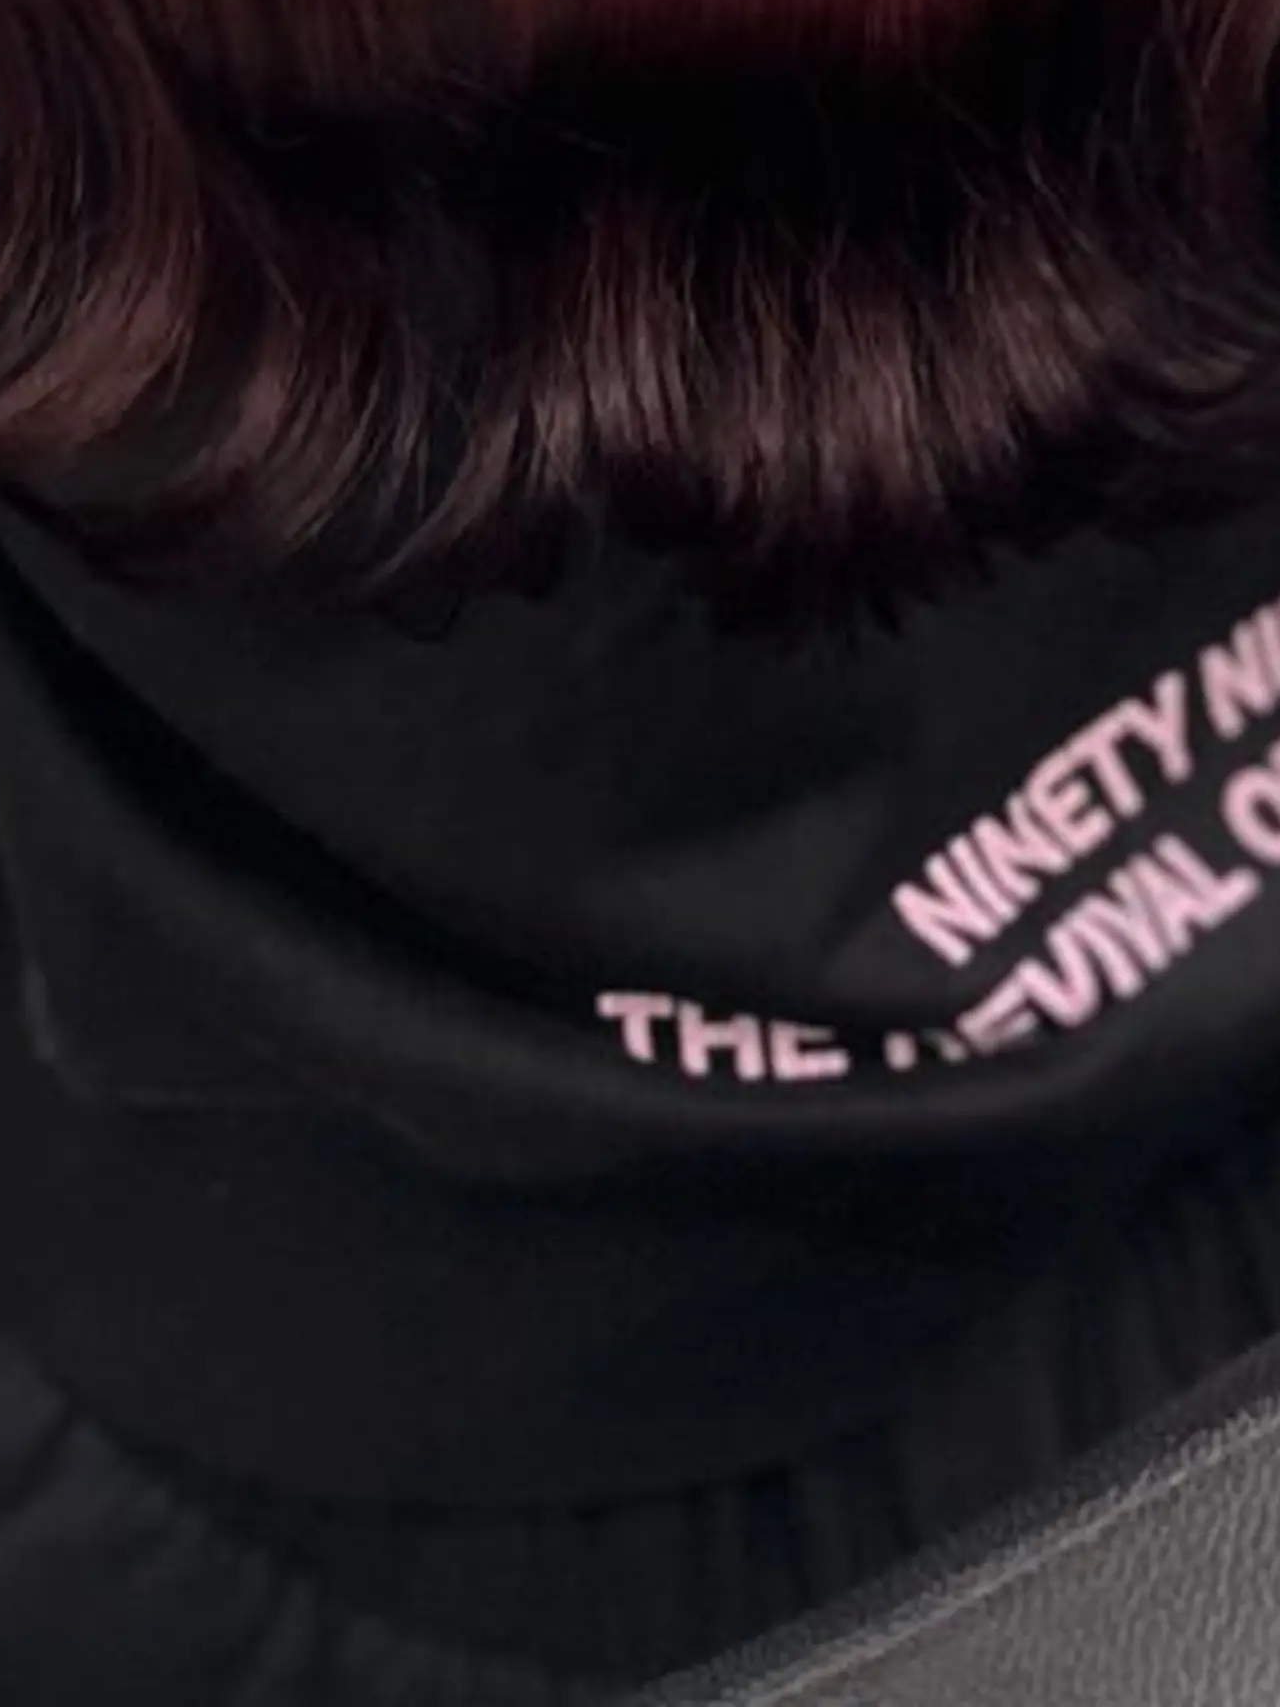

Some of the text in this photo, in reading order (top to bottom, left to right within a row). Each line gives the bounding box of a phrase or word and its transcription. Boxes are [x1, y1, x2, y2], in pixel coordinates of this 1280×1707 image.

[891, 670, 1192, 967] NINETY
[595, 992, 849, 1080] THE
[884, 832, 1262, 1072] EVIVAL
